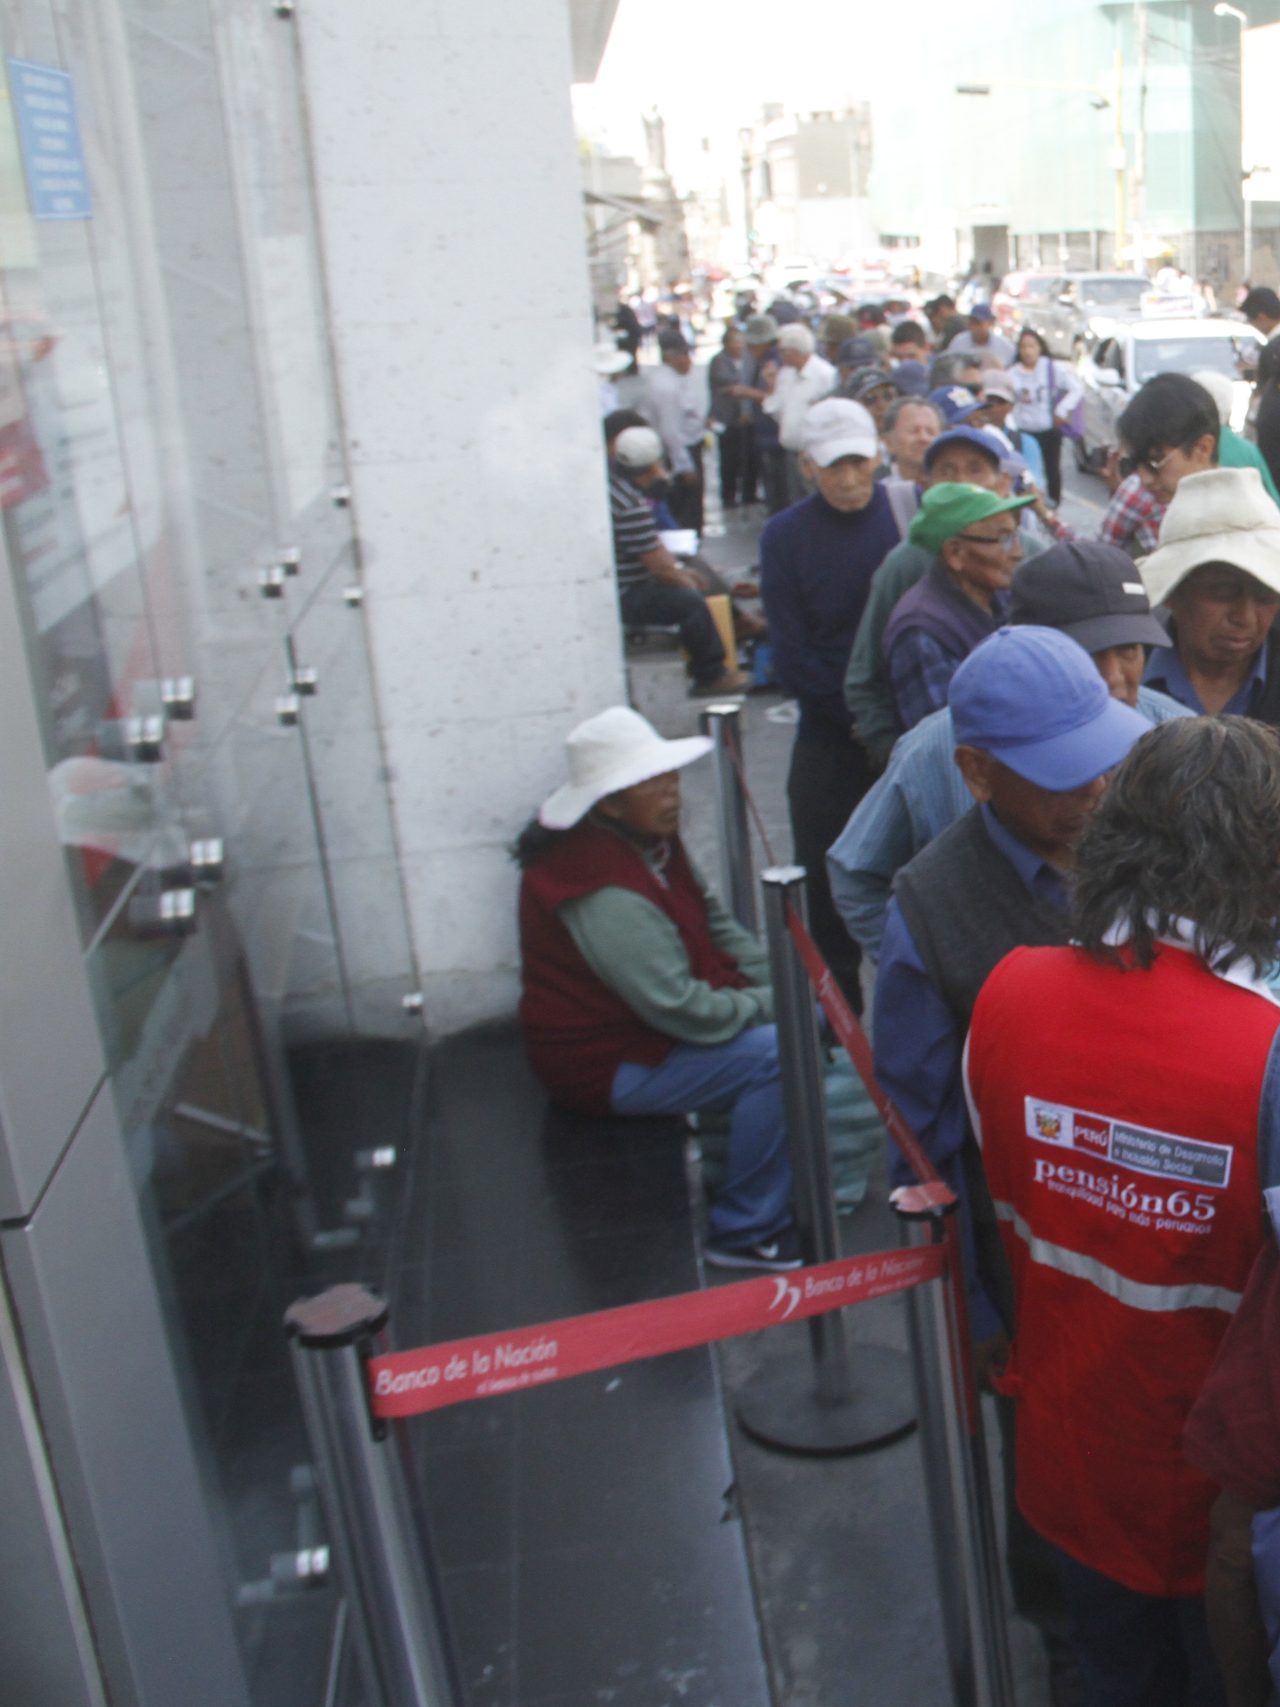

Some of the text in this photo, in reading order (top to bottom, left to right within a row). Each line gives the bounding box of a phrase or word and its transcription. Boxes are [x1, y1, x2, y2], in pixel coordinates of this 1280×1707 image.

[1074, 1125, 1108, 1147] PERÚ
[1114, 1131, 1224, 1167] Ministerio de Desarrollo
[1163, 1159, 1193, 1176] Social
[805, 1276, 845, 1298] Banco
[847, 1267, 862, 1287] de
[866, 1264, 878, 1282] la
[375, 1336, 558, 1396] Banco de la Nación
